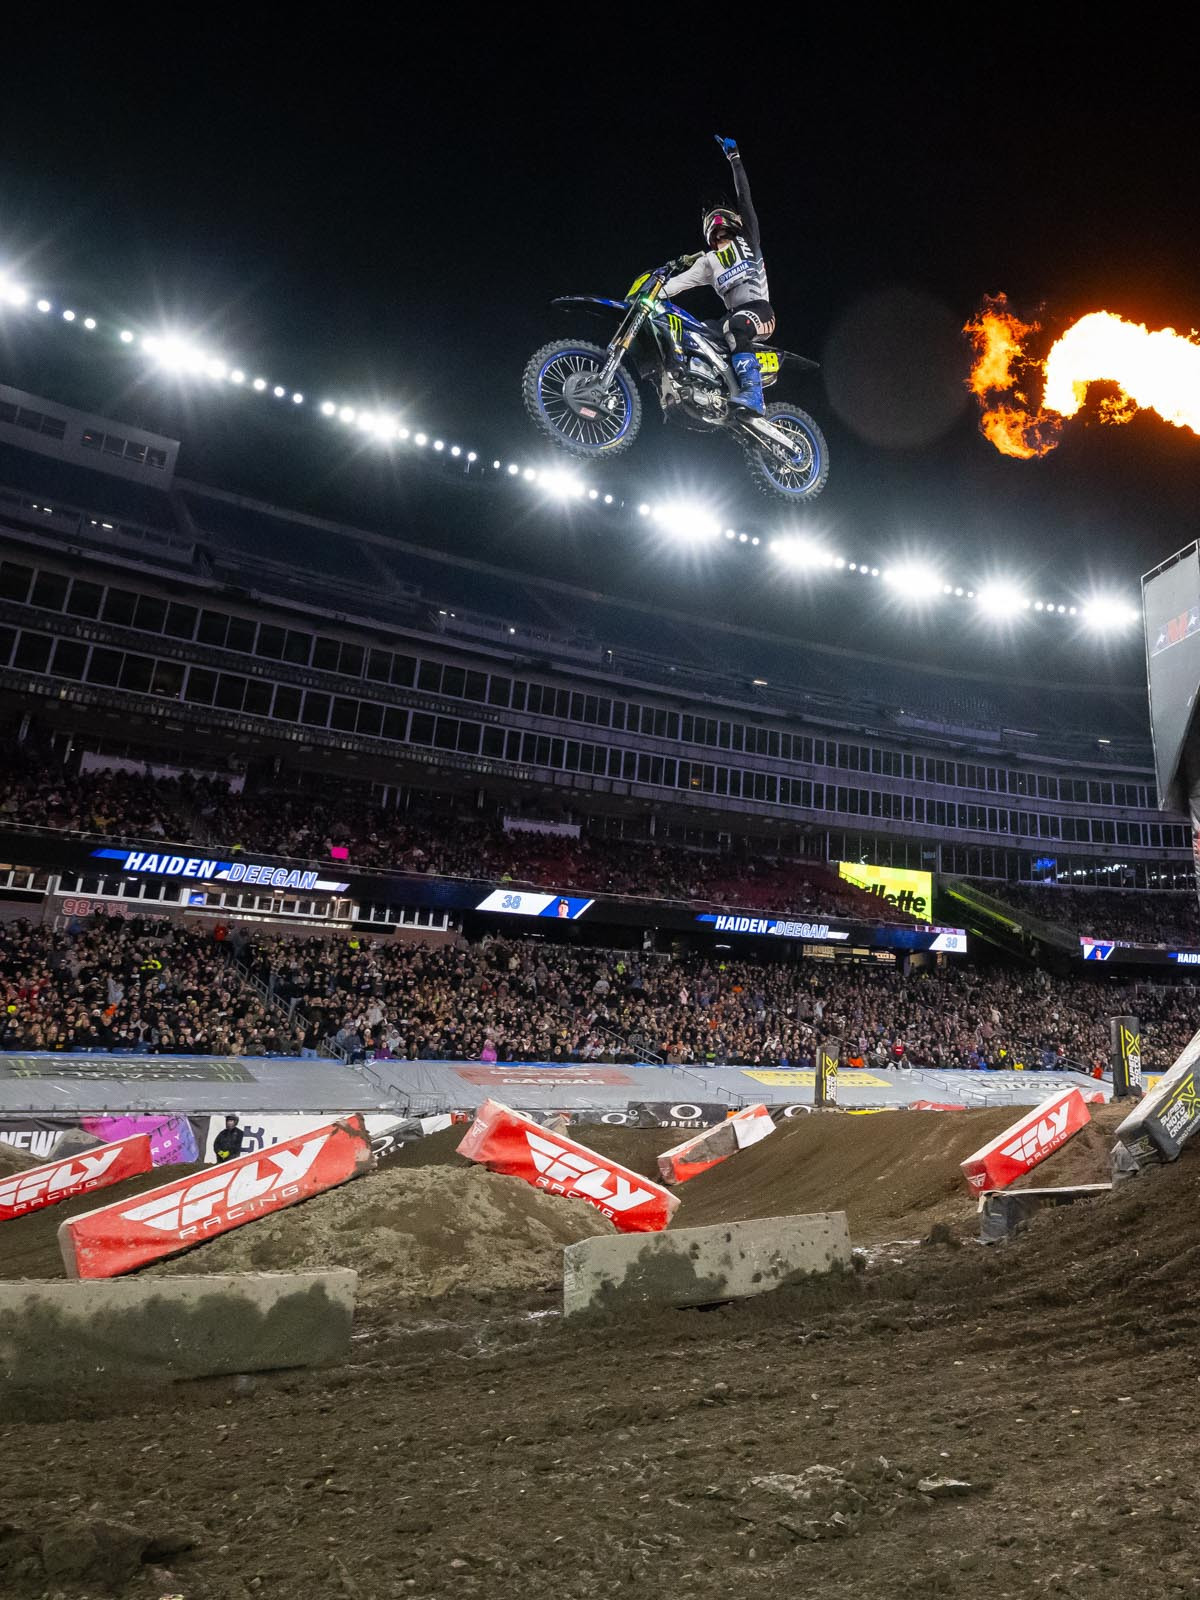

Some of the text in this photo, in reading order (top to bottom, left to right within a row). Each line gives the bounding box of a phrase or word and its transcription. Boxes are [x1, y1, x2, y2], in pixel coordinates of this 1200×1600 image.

[724, 262, 750, 280] YAMAHA
[756, 352, 780, 373] 38
[123, 852, 319, 890] HAIDEN DEEGAN
[502, 895, 522, 909] 38
[714, 915, 829, 939] HAIDEN DEEGAN
[660, 1120, 708, 1129] OAKLEY
[1160, 1101, 1184, 1126] SUPER
[1166, 1107, 1186, 1131] MOTO
[1169, 1112, 1189, 1138] CROSS
[1000, 1101, 1070, 1162] FLY
[1026, 1131, 1068, 1167] RACING
[0, 1147, 124, 1207] FLY
[119, 1133, 329, 1231] FLY
[525, 1130, 656, 1211] FLY
[13, 1180, 98, 1213] RACING
[178, 1185, 299, 1240] RACING
